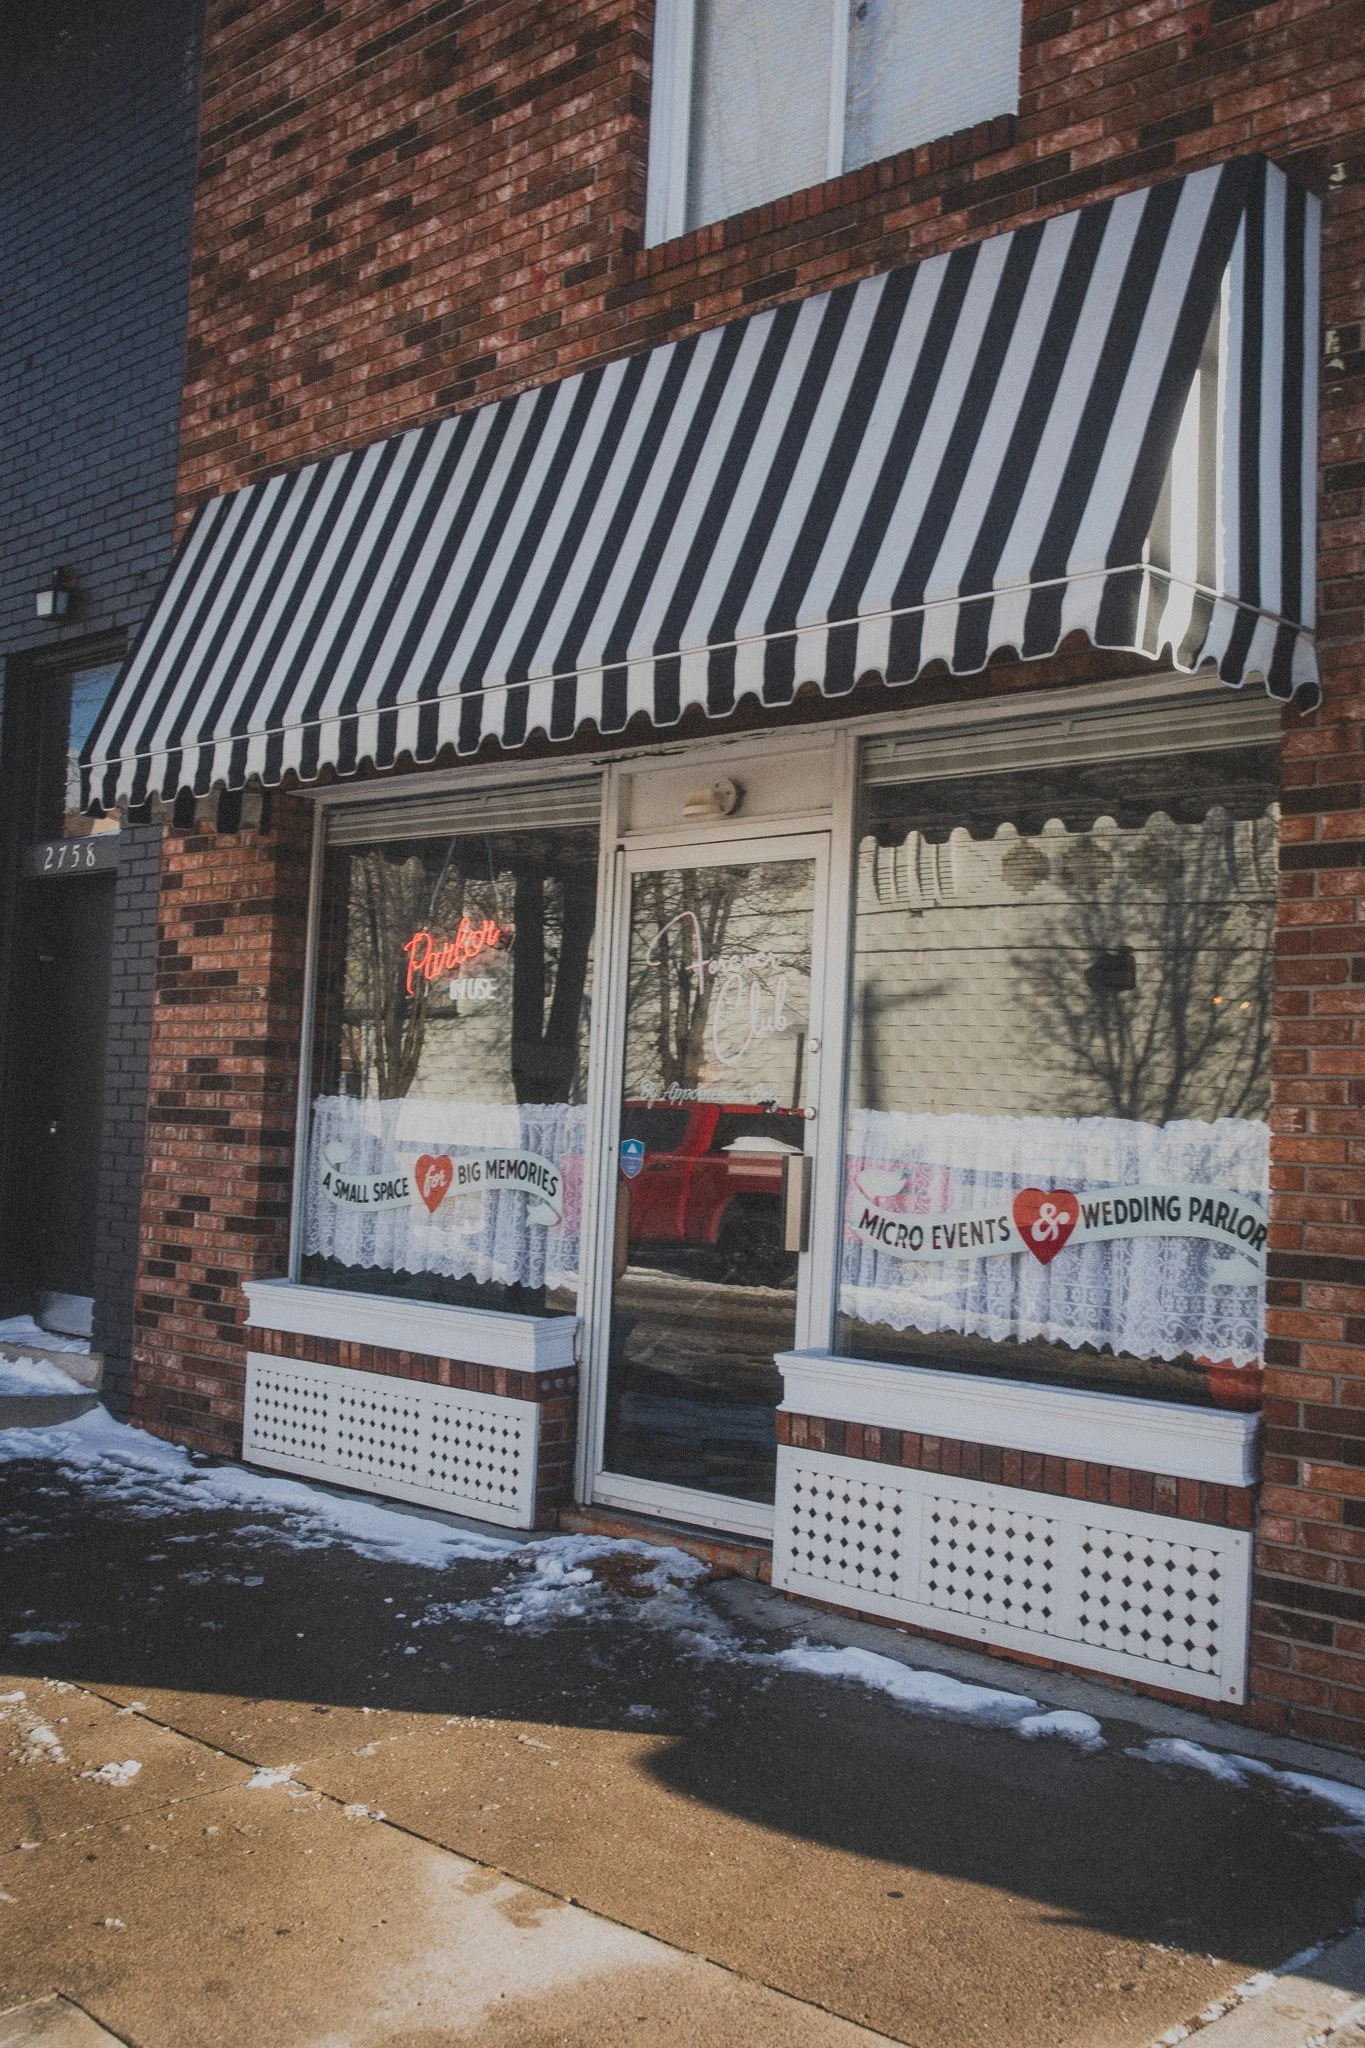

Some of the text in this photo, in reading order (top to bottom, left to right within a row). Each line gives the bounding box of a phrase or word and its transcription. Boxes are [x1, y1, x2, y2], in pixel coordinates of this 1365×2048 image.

[43, 842, 96, 870] 2758
[403, 917, 502, 994] Parlor
[467, 978, 498, 1000] USE
[713, 973, 795, 1067] Club
[322, 1158, 559, 1204] A SMALL SPACE for BIG MEMORIES
[858, 1195, 1267, 1251] MICRO EVENTS & WEDDING PARLOR
